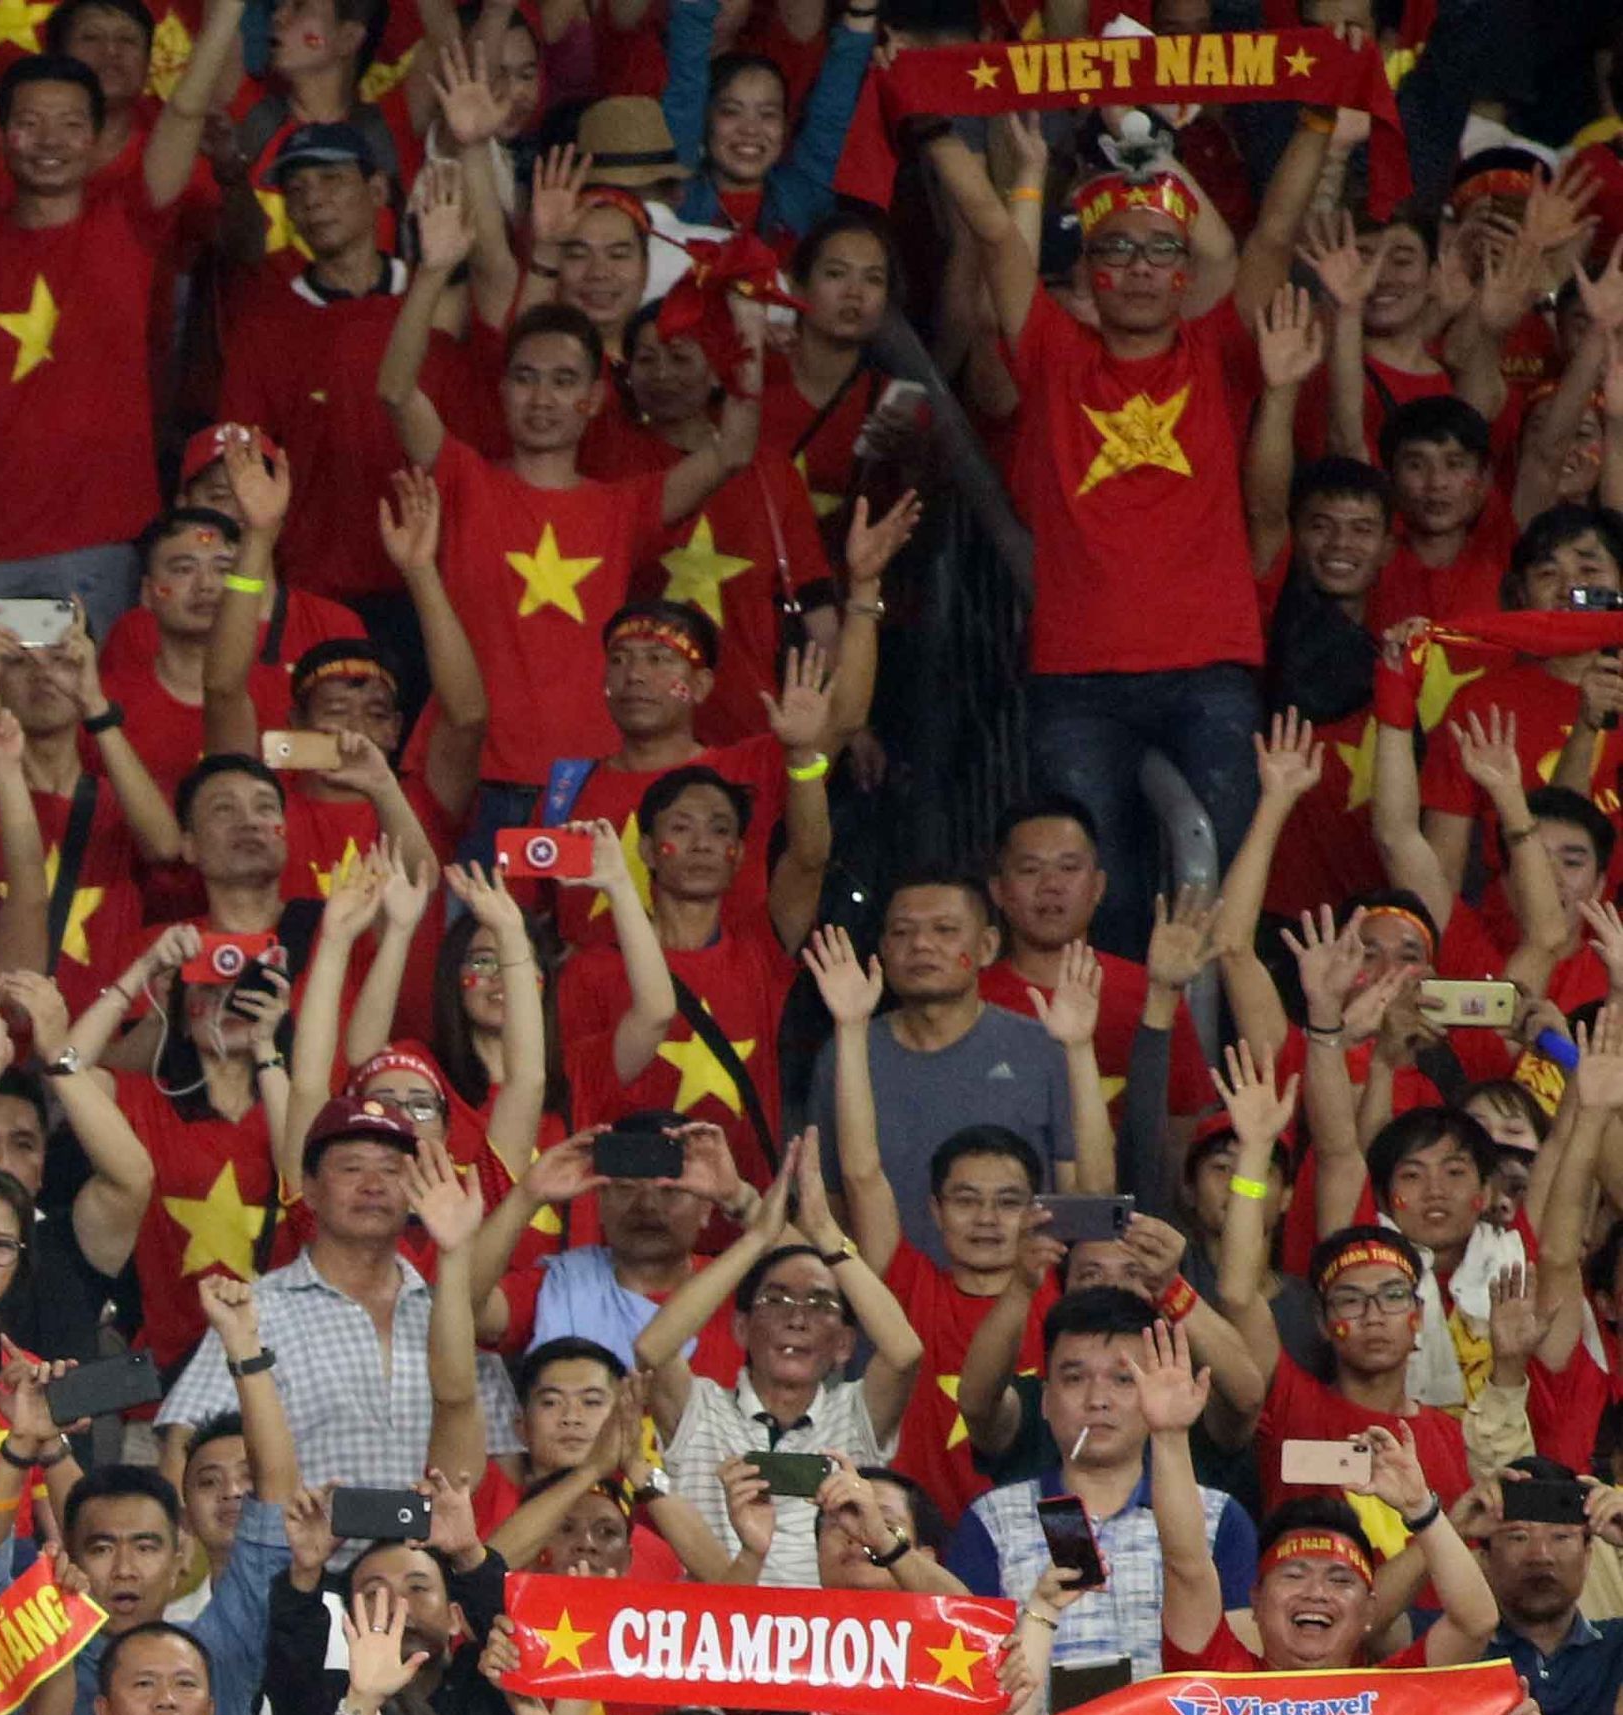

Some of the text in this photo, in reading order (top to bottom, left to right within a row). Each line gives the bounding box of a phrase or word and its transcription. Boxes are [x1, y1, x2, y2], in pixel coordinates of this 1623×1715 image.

[1007, 34, 1278, 105] VIỆT NAM
[607, 1605, 912, 1692] CHAMPION
